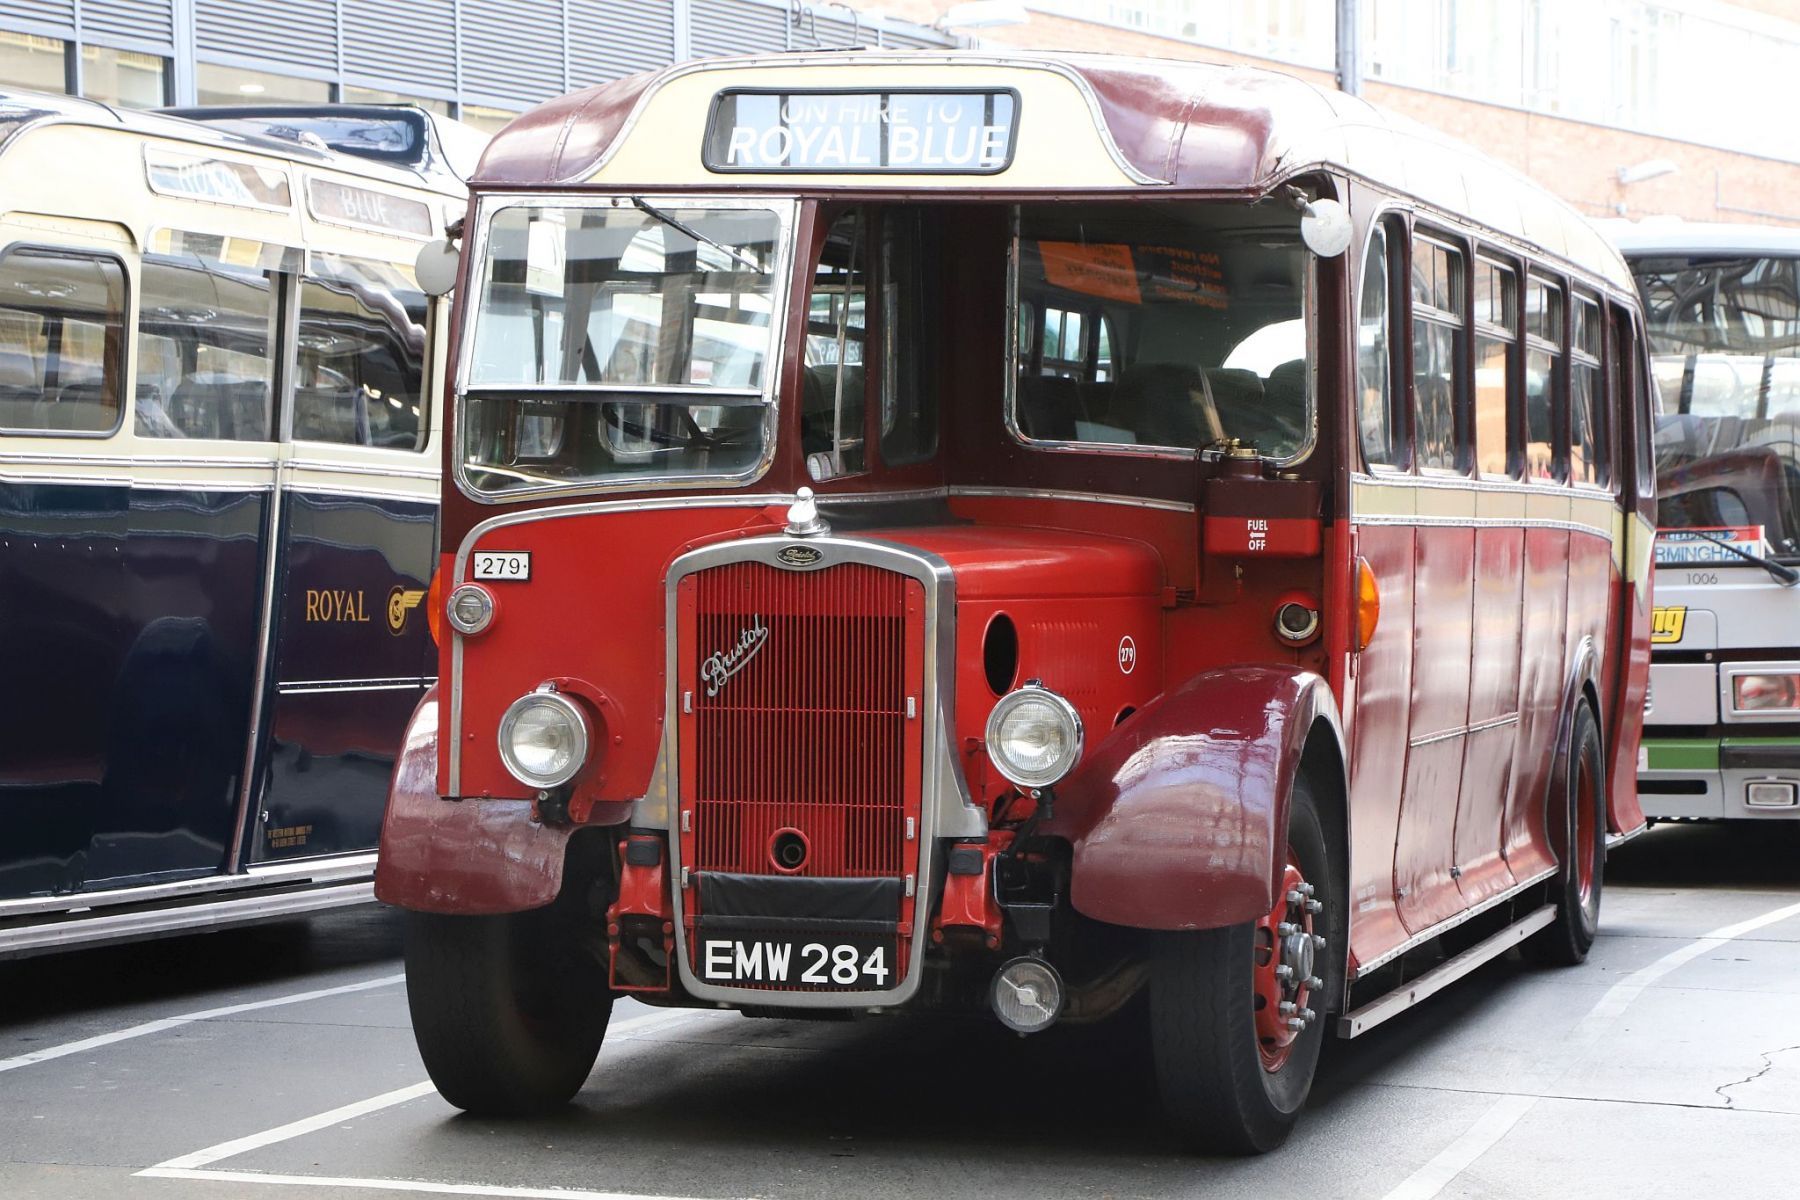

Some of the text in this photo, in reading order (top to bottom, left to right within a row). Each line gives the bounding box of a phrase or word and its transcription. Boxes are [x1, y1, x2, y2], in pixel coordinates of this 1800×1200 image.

[780, 100, 964, 124] ON HIRE TO
[726, 125, 1008, 164] ROYAL BLUE
[340, 186, 390, 225] BLUE
[1247, 519, 1269, 531] FUEL
[1248, 539, 1266, 551] OFF
[481, 557, 521, 575] 279
[1686, 573, 1719, 585] 1006
[305, 590, 370, 622] ROYAL
[701, 612, 769, 697] Bristol
[1121, 647, 1134, 662] 279
[705, 940, 889, 986] EMW 284
